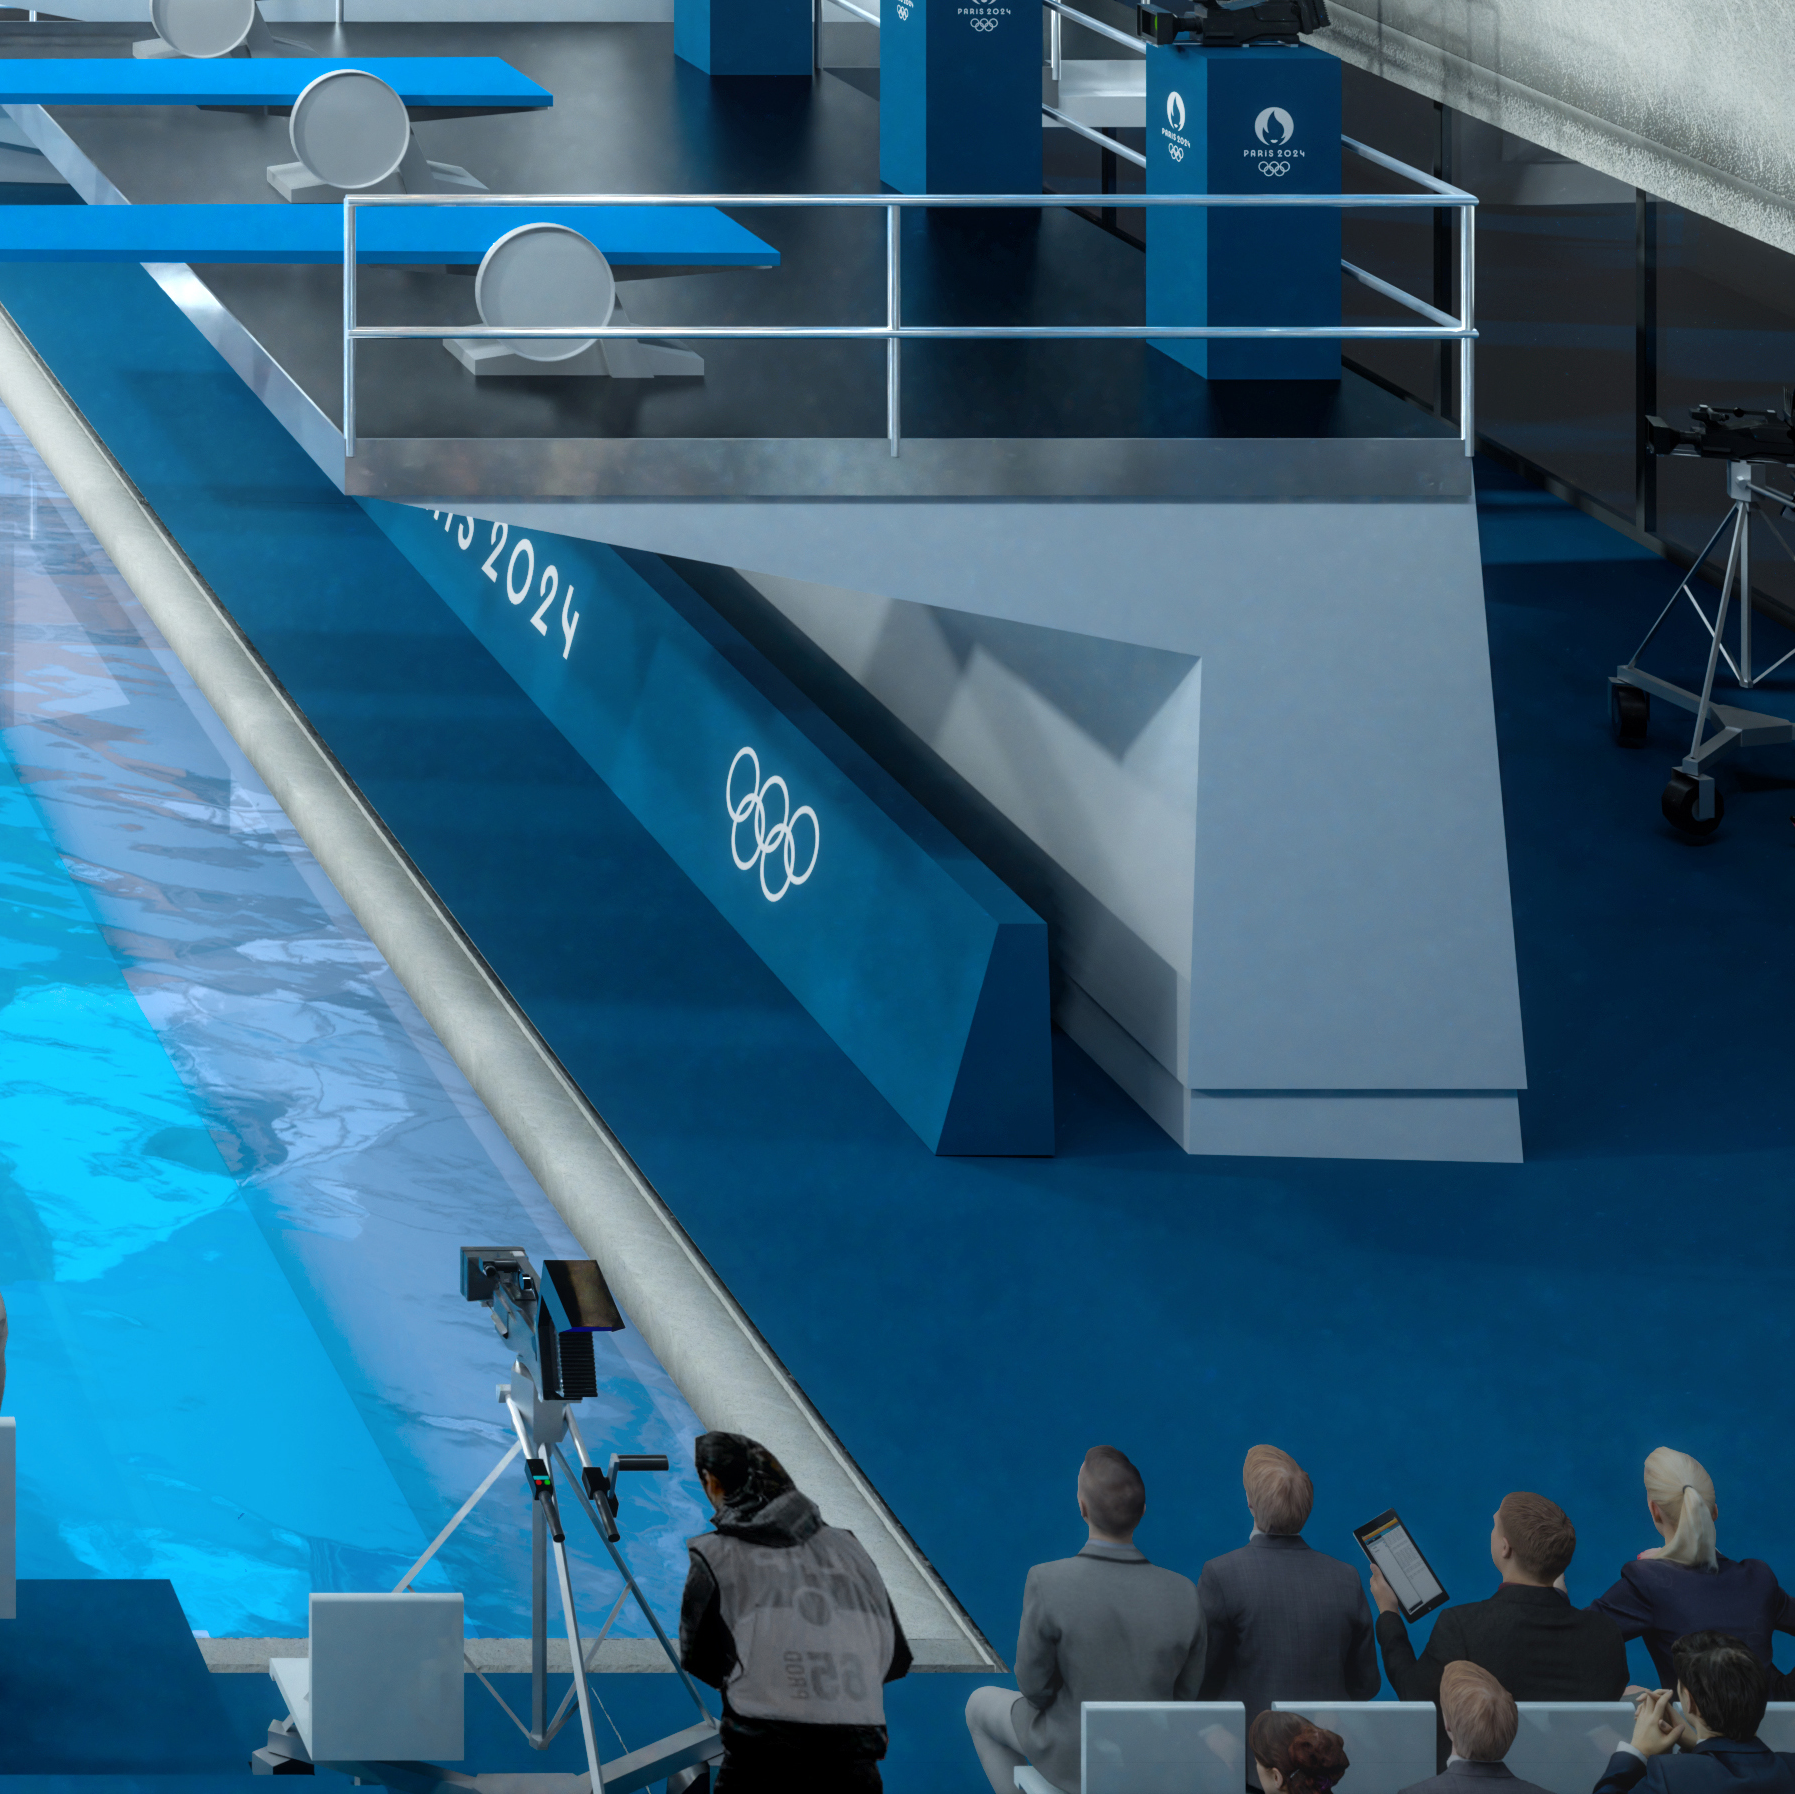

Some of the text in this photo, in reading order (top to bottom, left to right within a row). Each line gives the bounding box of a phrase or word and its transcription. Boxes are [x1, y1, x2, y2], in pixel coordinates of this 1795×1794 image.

[986, 7, 1012, 16] 2024
[1176, 135, 1191, 149] 2024
[1276, 149, 1306, 159] 2024
[481, 521, 580, 660] 2024
